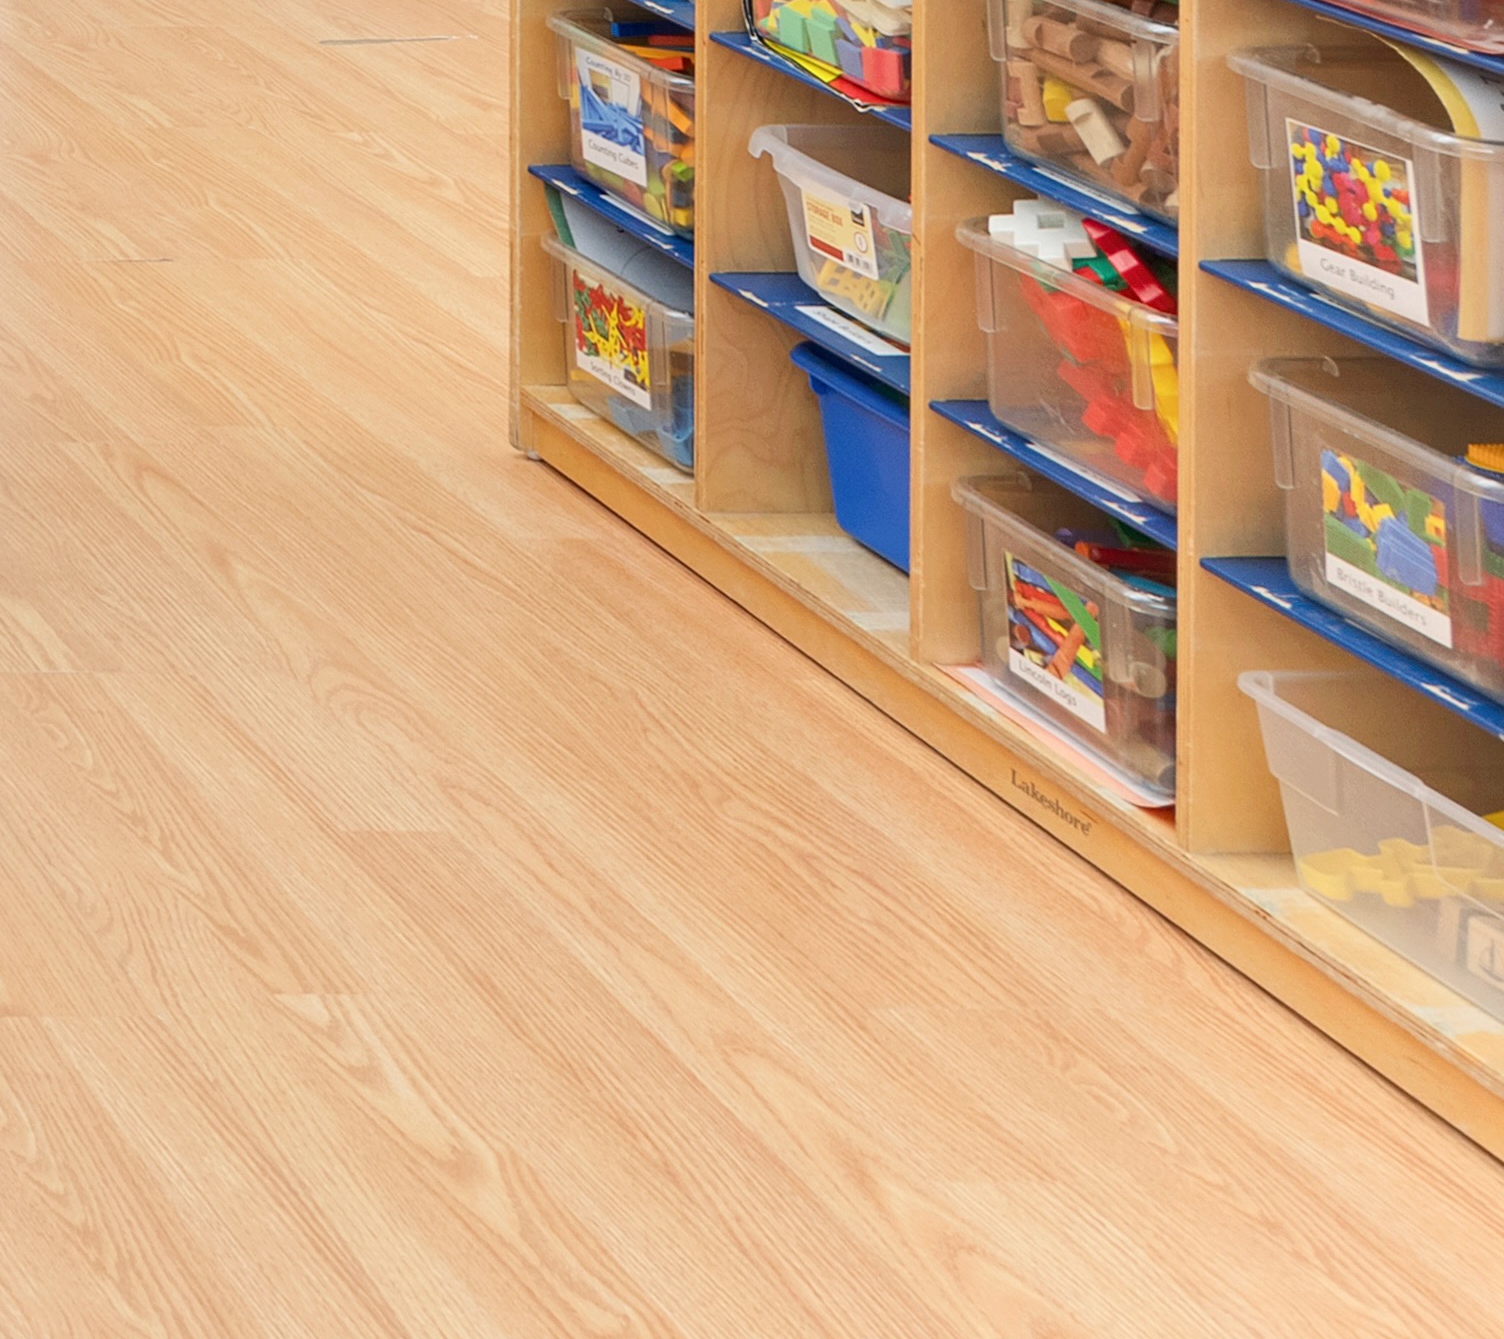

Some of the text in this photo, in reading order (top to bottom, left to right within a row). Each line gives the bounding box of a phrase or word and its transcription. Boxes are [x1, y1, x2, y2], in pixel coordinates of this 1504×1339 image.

[586, 57, 613, 75] Counting
[588, 139, 617, 164] Counting
[1319, 257, 1395, 301] Gear Building
[1336, 566, 1427, 628] Bristle Builders
[1018, 659, 1078, 708] Lincoln Logs
[1010, 768, 1091, 837] Lakeshore
